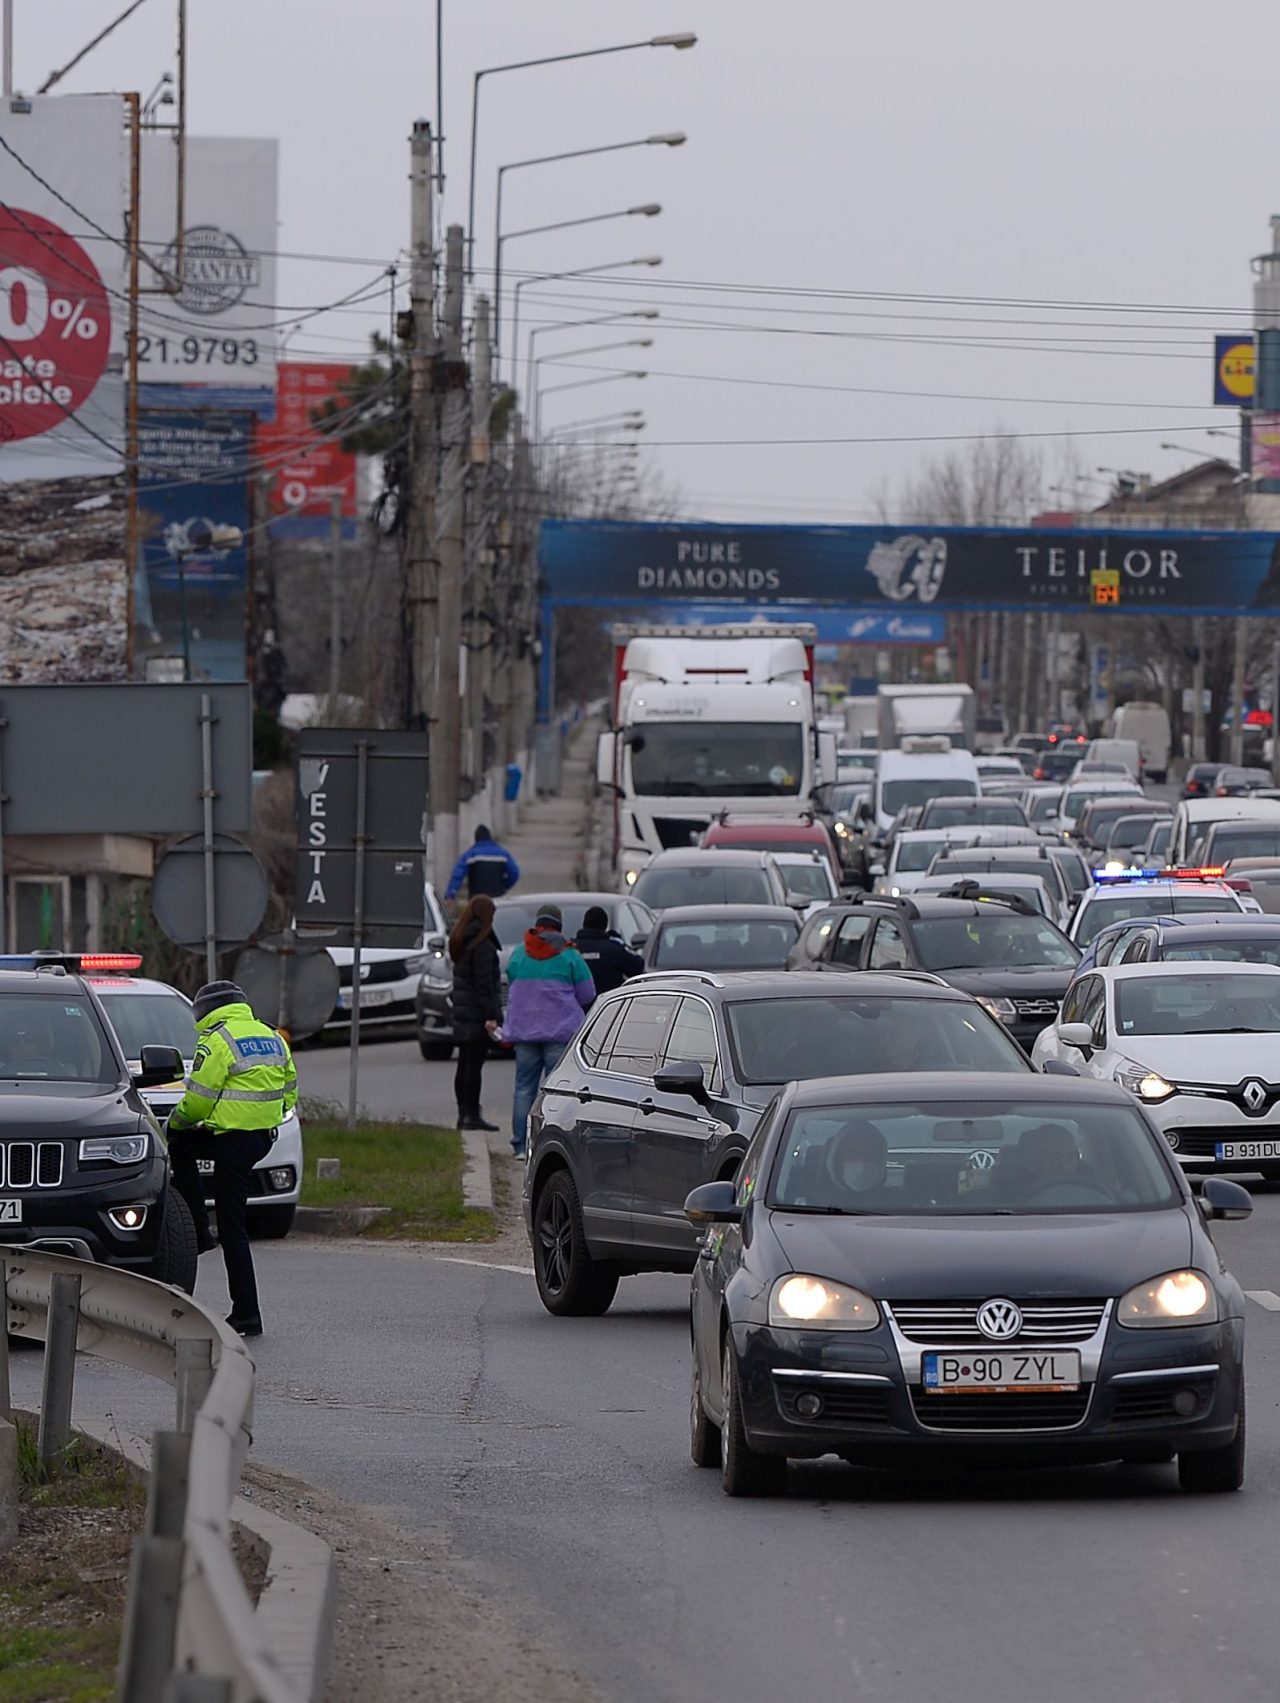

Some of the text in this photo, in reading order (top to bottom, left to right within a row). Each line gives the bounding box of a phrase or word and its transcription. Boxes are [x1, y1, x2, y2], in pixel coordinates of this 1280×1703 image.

[678, 541, 742, 563] PURE
[638, 567, 780, 590] DIAMONDS
[1224, 1144, 1234, 1158] B
[943, 1357, 1065, 1382] B 90 ZYL
